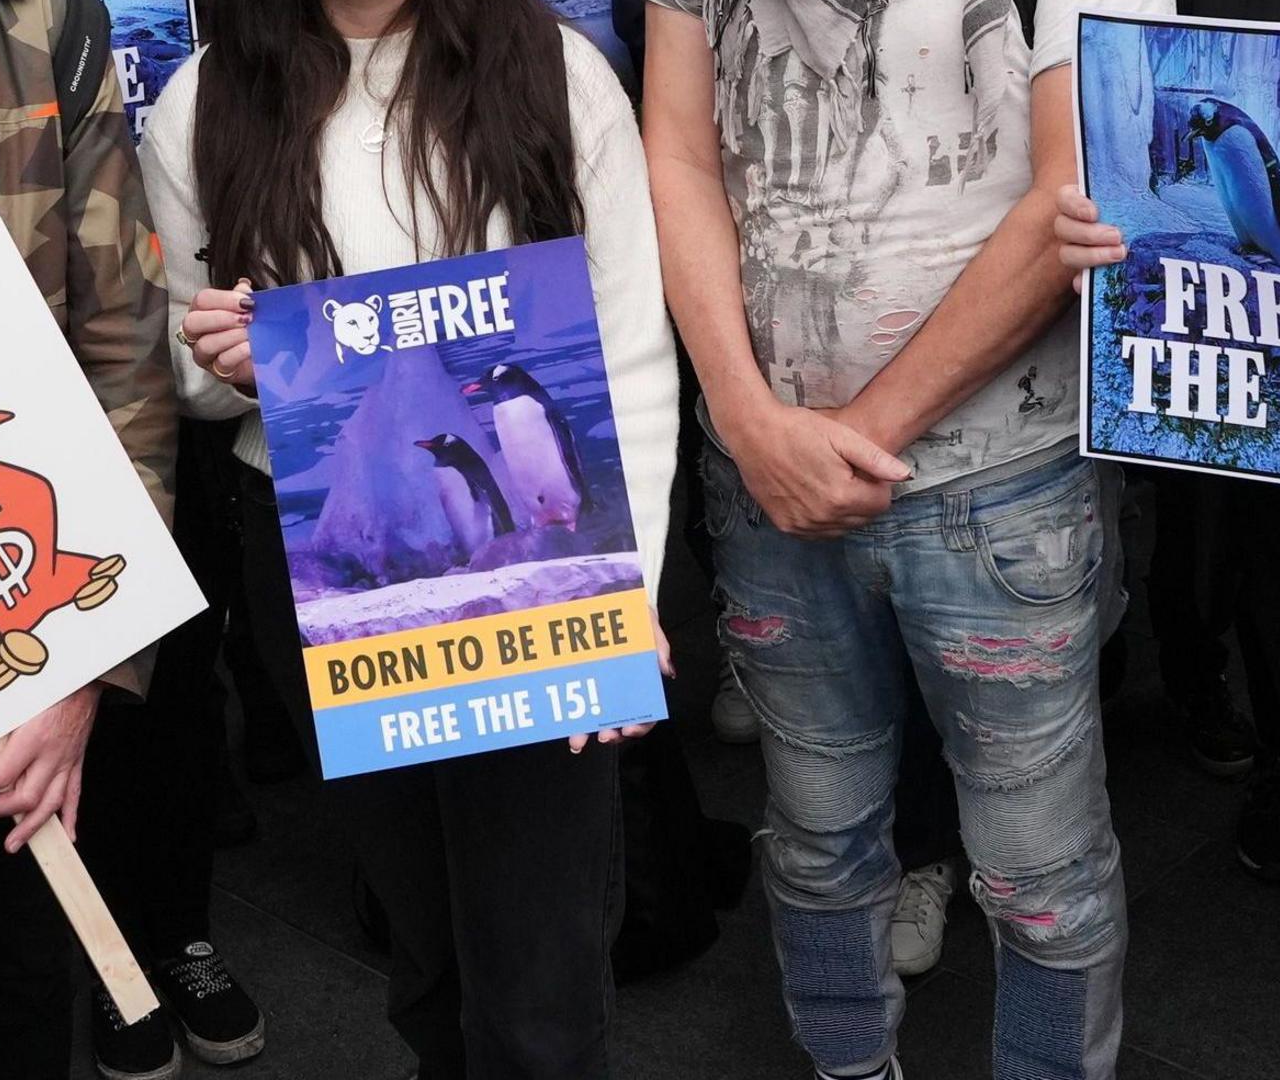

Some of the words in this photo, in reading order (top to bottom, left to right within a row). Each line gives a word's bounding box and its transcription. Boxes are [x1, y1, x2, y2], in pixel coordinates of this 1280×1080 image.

[70, 37, 91, 92] GROUNDTRUTH
[388, 290, 423, 350] BORN
[418, 276, 515, 345] FREE
[1122, 335, 1268, 428] THE
[327, 644, 429, 695] BORN
[437, 635, 483, 676] TO
[496, 624, 537, 665] BE
[548, 608, 628, 656] FREE
[380, 704, 463, 752] FREE
[468, 690, 534, 735] THE
[545, 677, 601, 720] 15!
